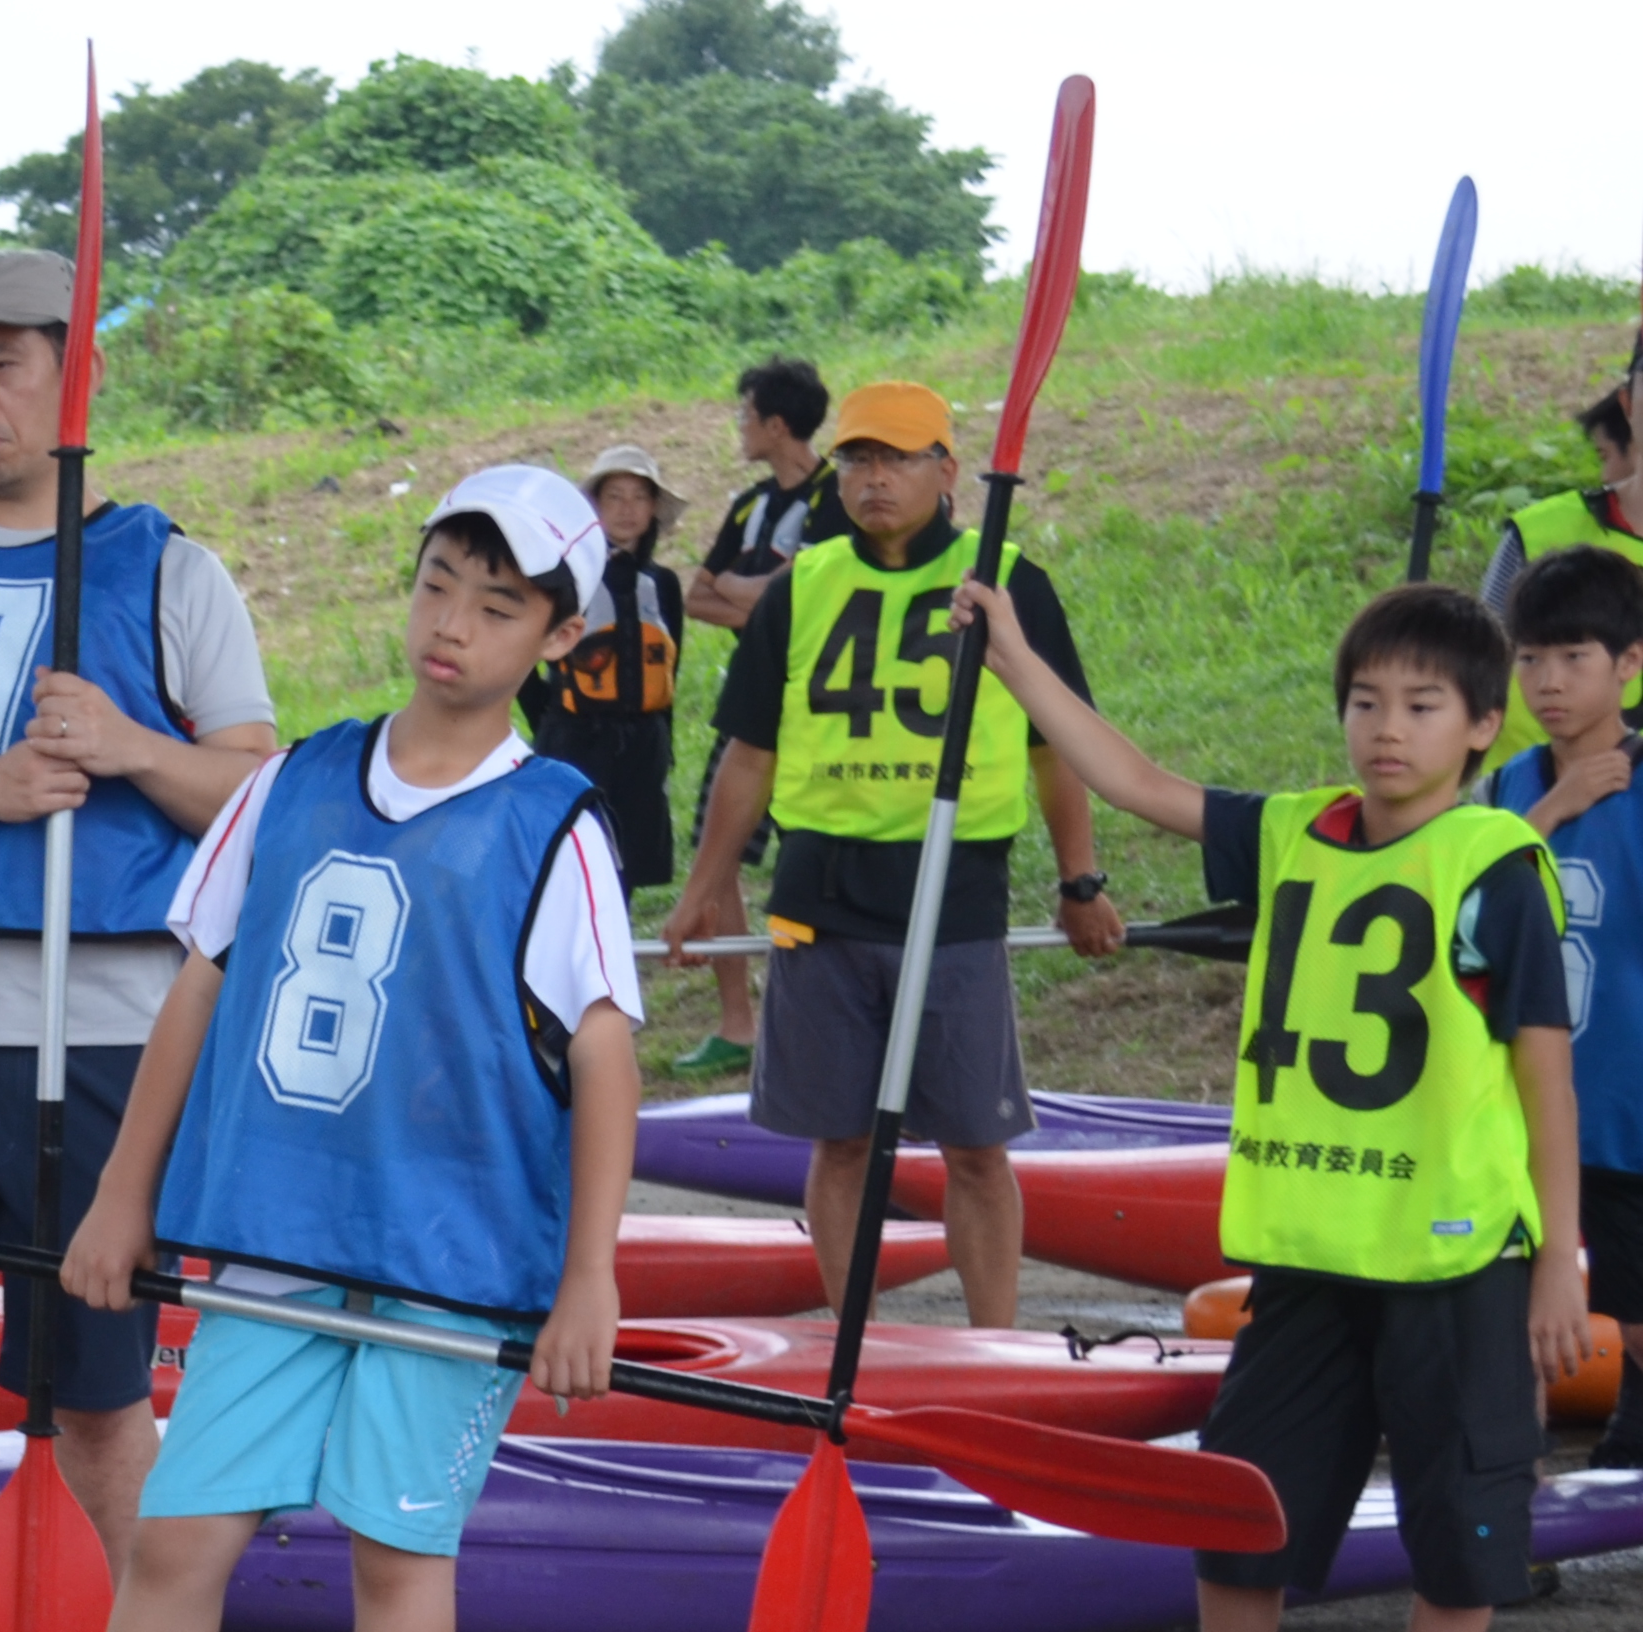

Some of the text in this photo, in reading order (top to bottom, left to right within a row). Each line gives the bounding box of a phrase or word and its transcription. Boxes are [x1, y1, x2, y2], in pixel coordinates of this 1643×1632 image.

[808, 587, 960, 739] 45
[257, 849, 411, 1114] 8
[1241, 879, 1436, 1111] 43
